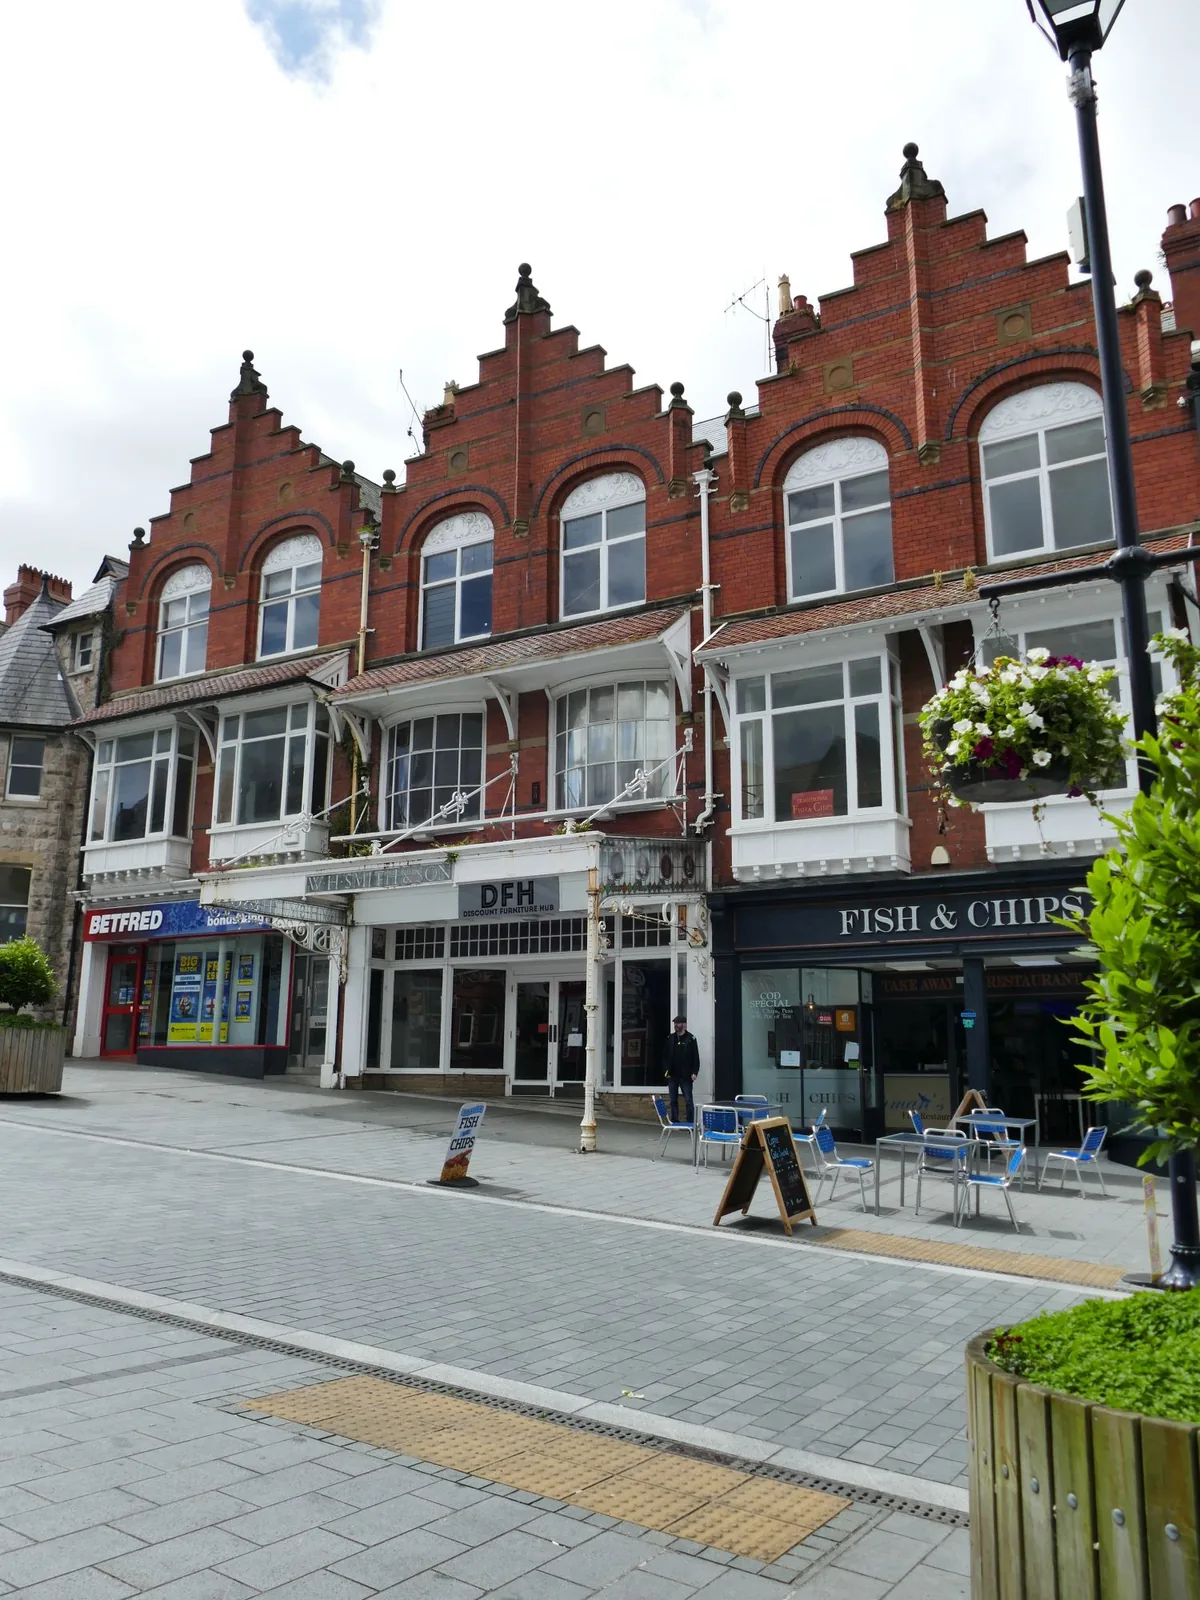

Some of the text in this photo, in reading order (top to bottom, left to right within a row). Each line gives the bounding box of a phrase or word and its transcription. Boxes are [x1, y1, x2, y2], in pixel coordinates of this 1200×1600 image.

[416, 864, 451, 882] SON
[481, 880, 534, 908] DFH
[463, 904, 554, 917] DISCOUNT FURNITURE HUB
[838, 895, 1085, 936] FISH & CHIPS
[89, 911, 163, 935] BETFRED
[180, 956, 198, 967] BIG
[207, 960, 231, 971] FRE
[881, 972, 1081, 992] TAKE AWAY RESTAURANT
[760, 991, 781, 999] COD
[749, 999, 791, 1008] SPECIAL
[458, 1116, 480, 1129] FISH
[450, 1136, 476, 1151] CHIPS
